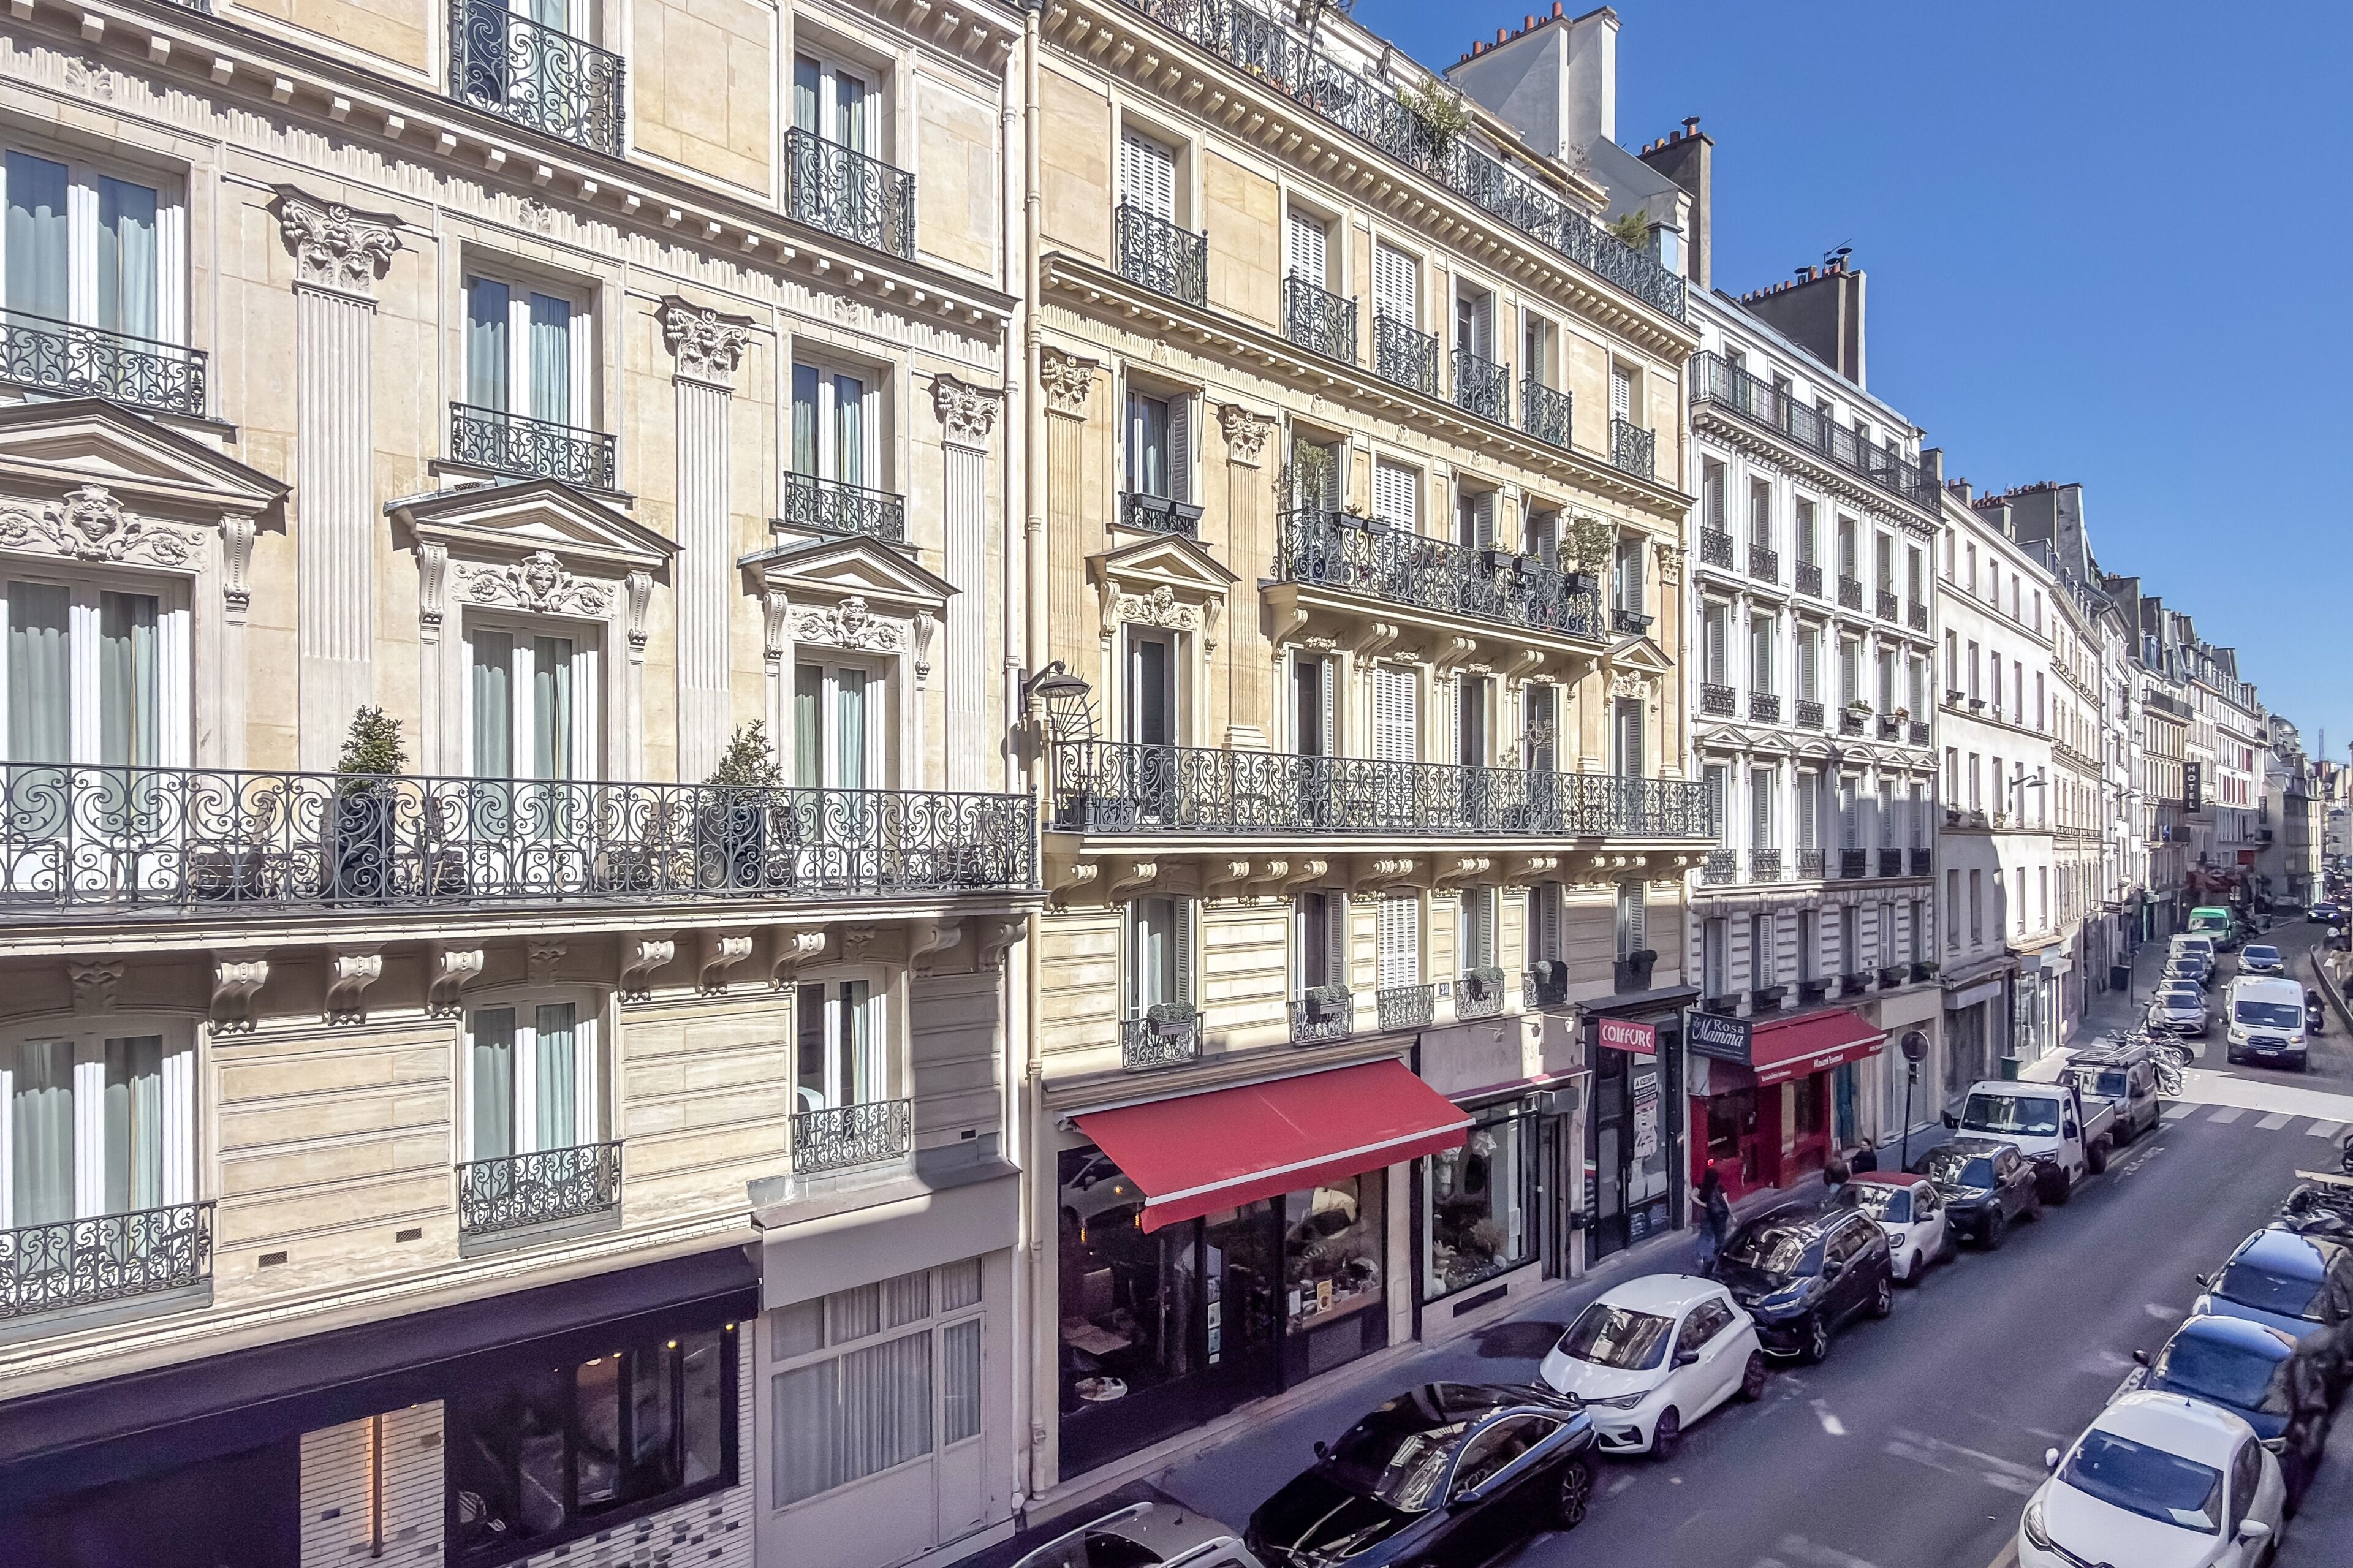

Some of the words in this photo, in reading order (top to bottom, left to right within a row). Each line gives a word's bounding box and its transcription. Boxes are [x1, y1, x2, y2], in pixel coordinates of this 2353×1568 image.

[2187, 765, 2196, 808] HOTEL
[1441, 983, 1449, 994] 28
[1601, 1025, 1653, 1048] COIFFURE
[1692, 1018, 1745, 1047] Mamma
[1713, 1019, 1745, 1034] Rosa
